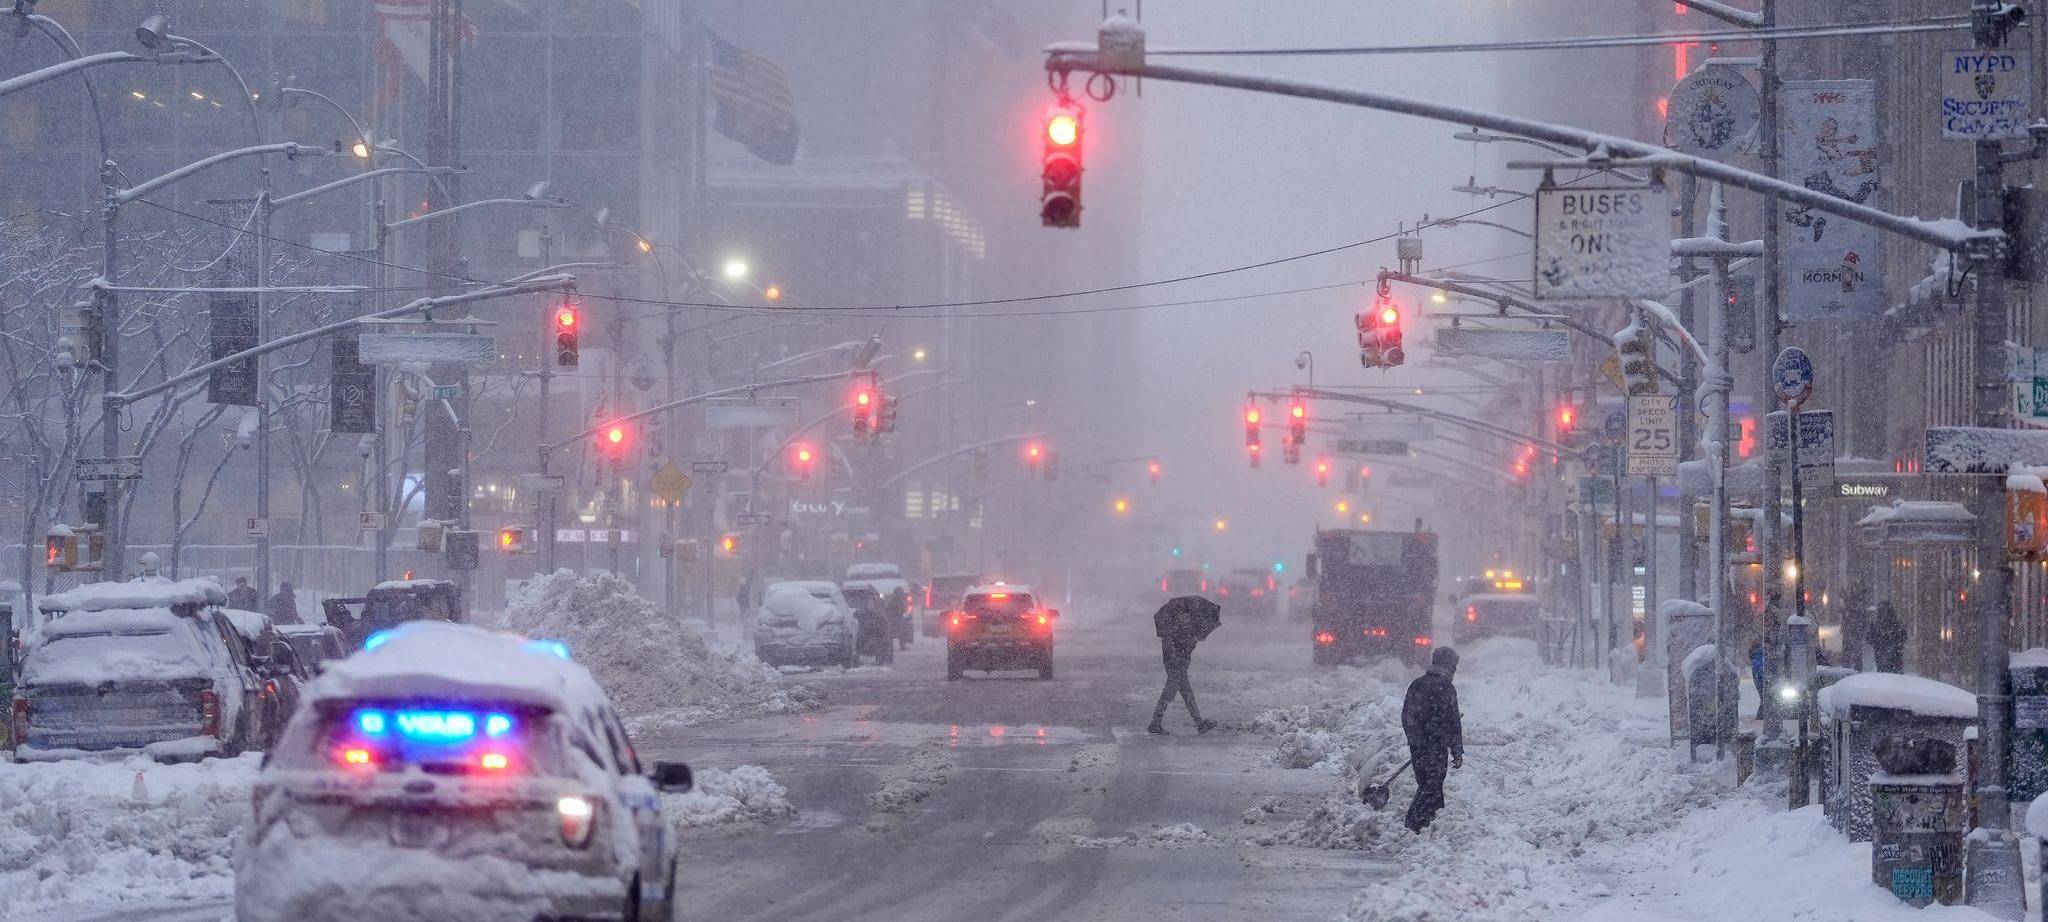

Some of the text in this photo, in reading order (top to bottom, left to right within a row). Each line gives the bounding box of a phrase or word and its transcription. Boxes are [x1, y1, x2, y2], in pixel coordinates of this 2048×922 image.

[1955, 55, 2015, 73] NYPD
[1563, 193, 1641, 215] BUSES
[1638, 408, 1666, 416] SPEED
[1641, 417, 1662, 425] LIMIT
[1634, 428, 1671, 450] 25
[1841, 484, 1887, 496] Subway
